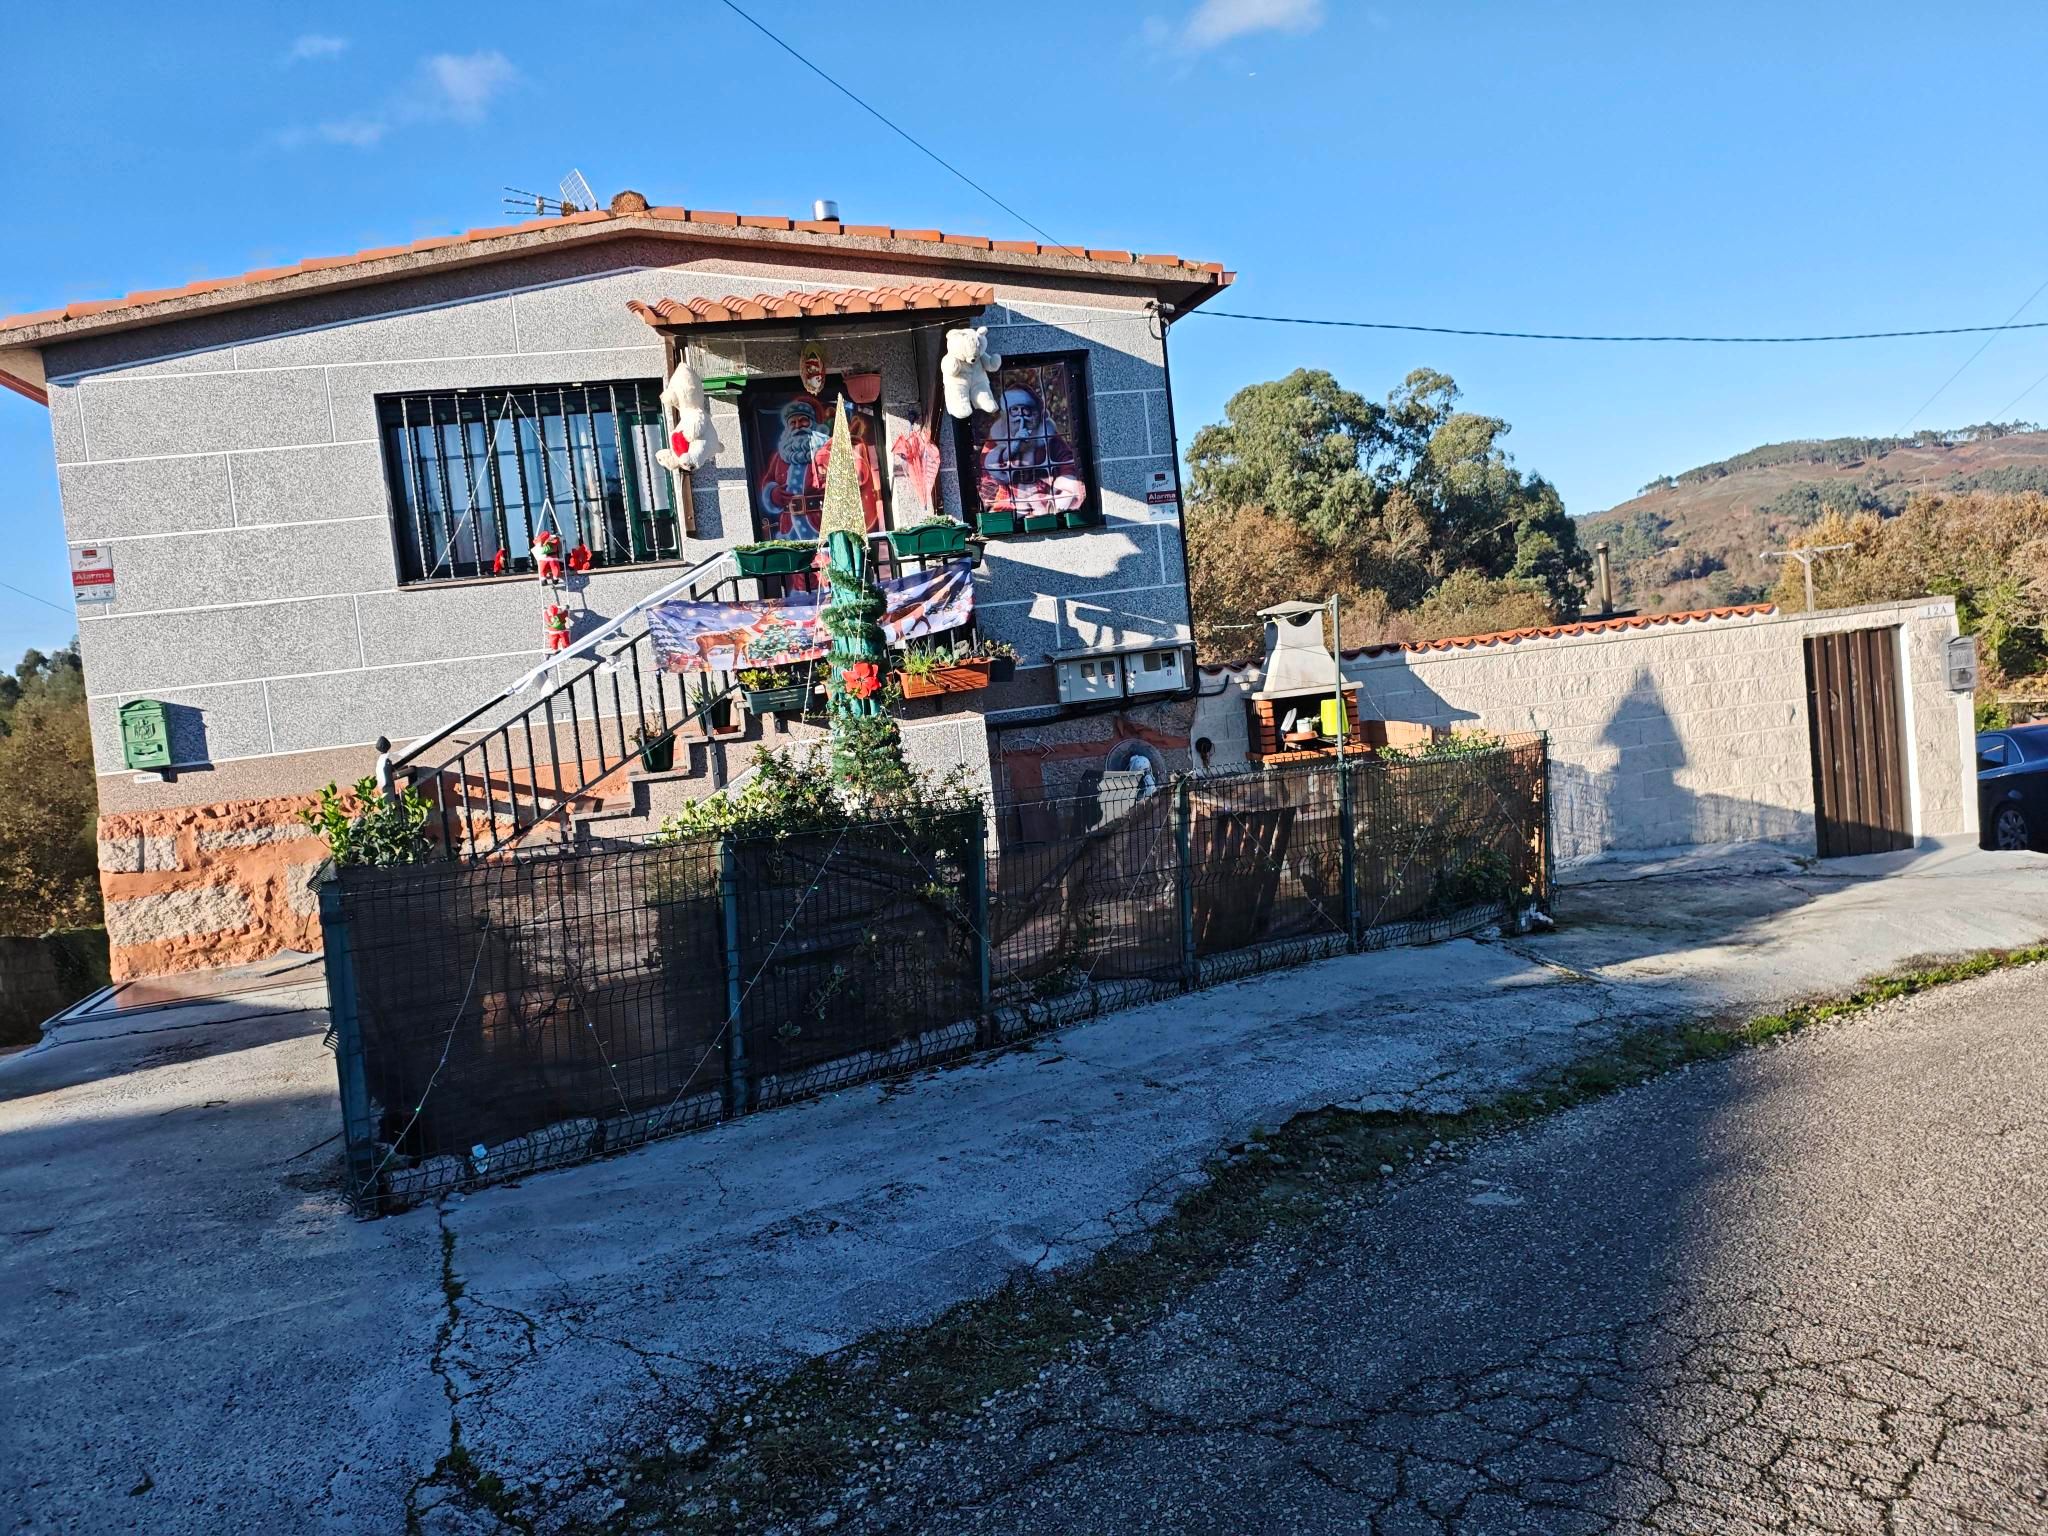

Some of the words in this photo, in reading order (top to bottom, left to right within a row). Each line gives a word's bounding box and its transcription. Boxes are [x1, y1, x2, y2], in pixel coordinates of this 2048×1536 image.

[1148, 492, 1176, 500] Alarma
[75, 572, 111, 581] Alarma
[1927, 605, 1947, 616] 12A
